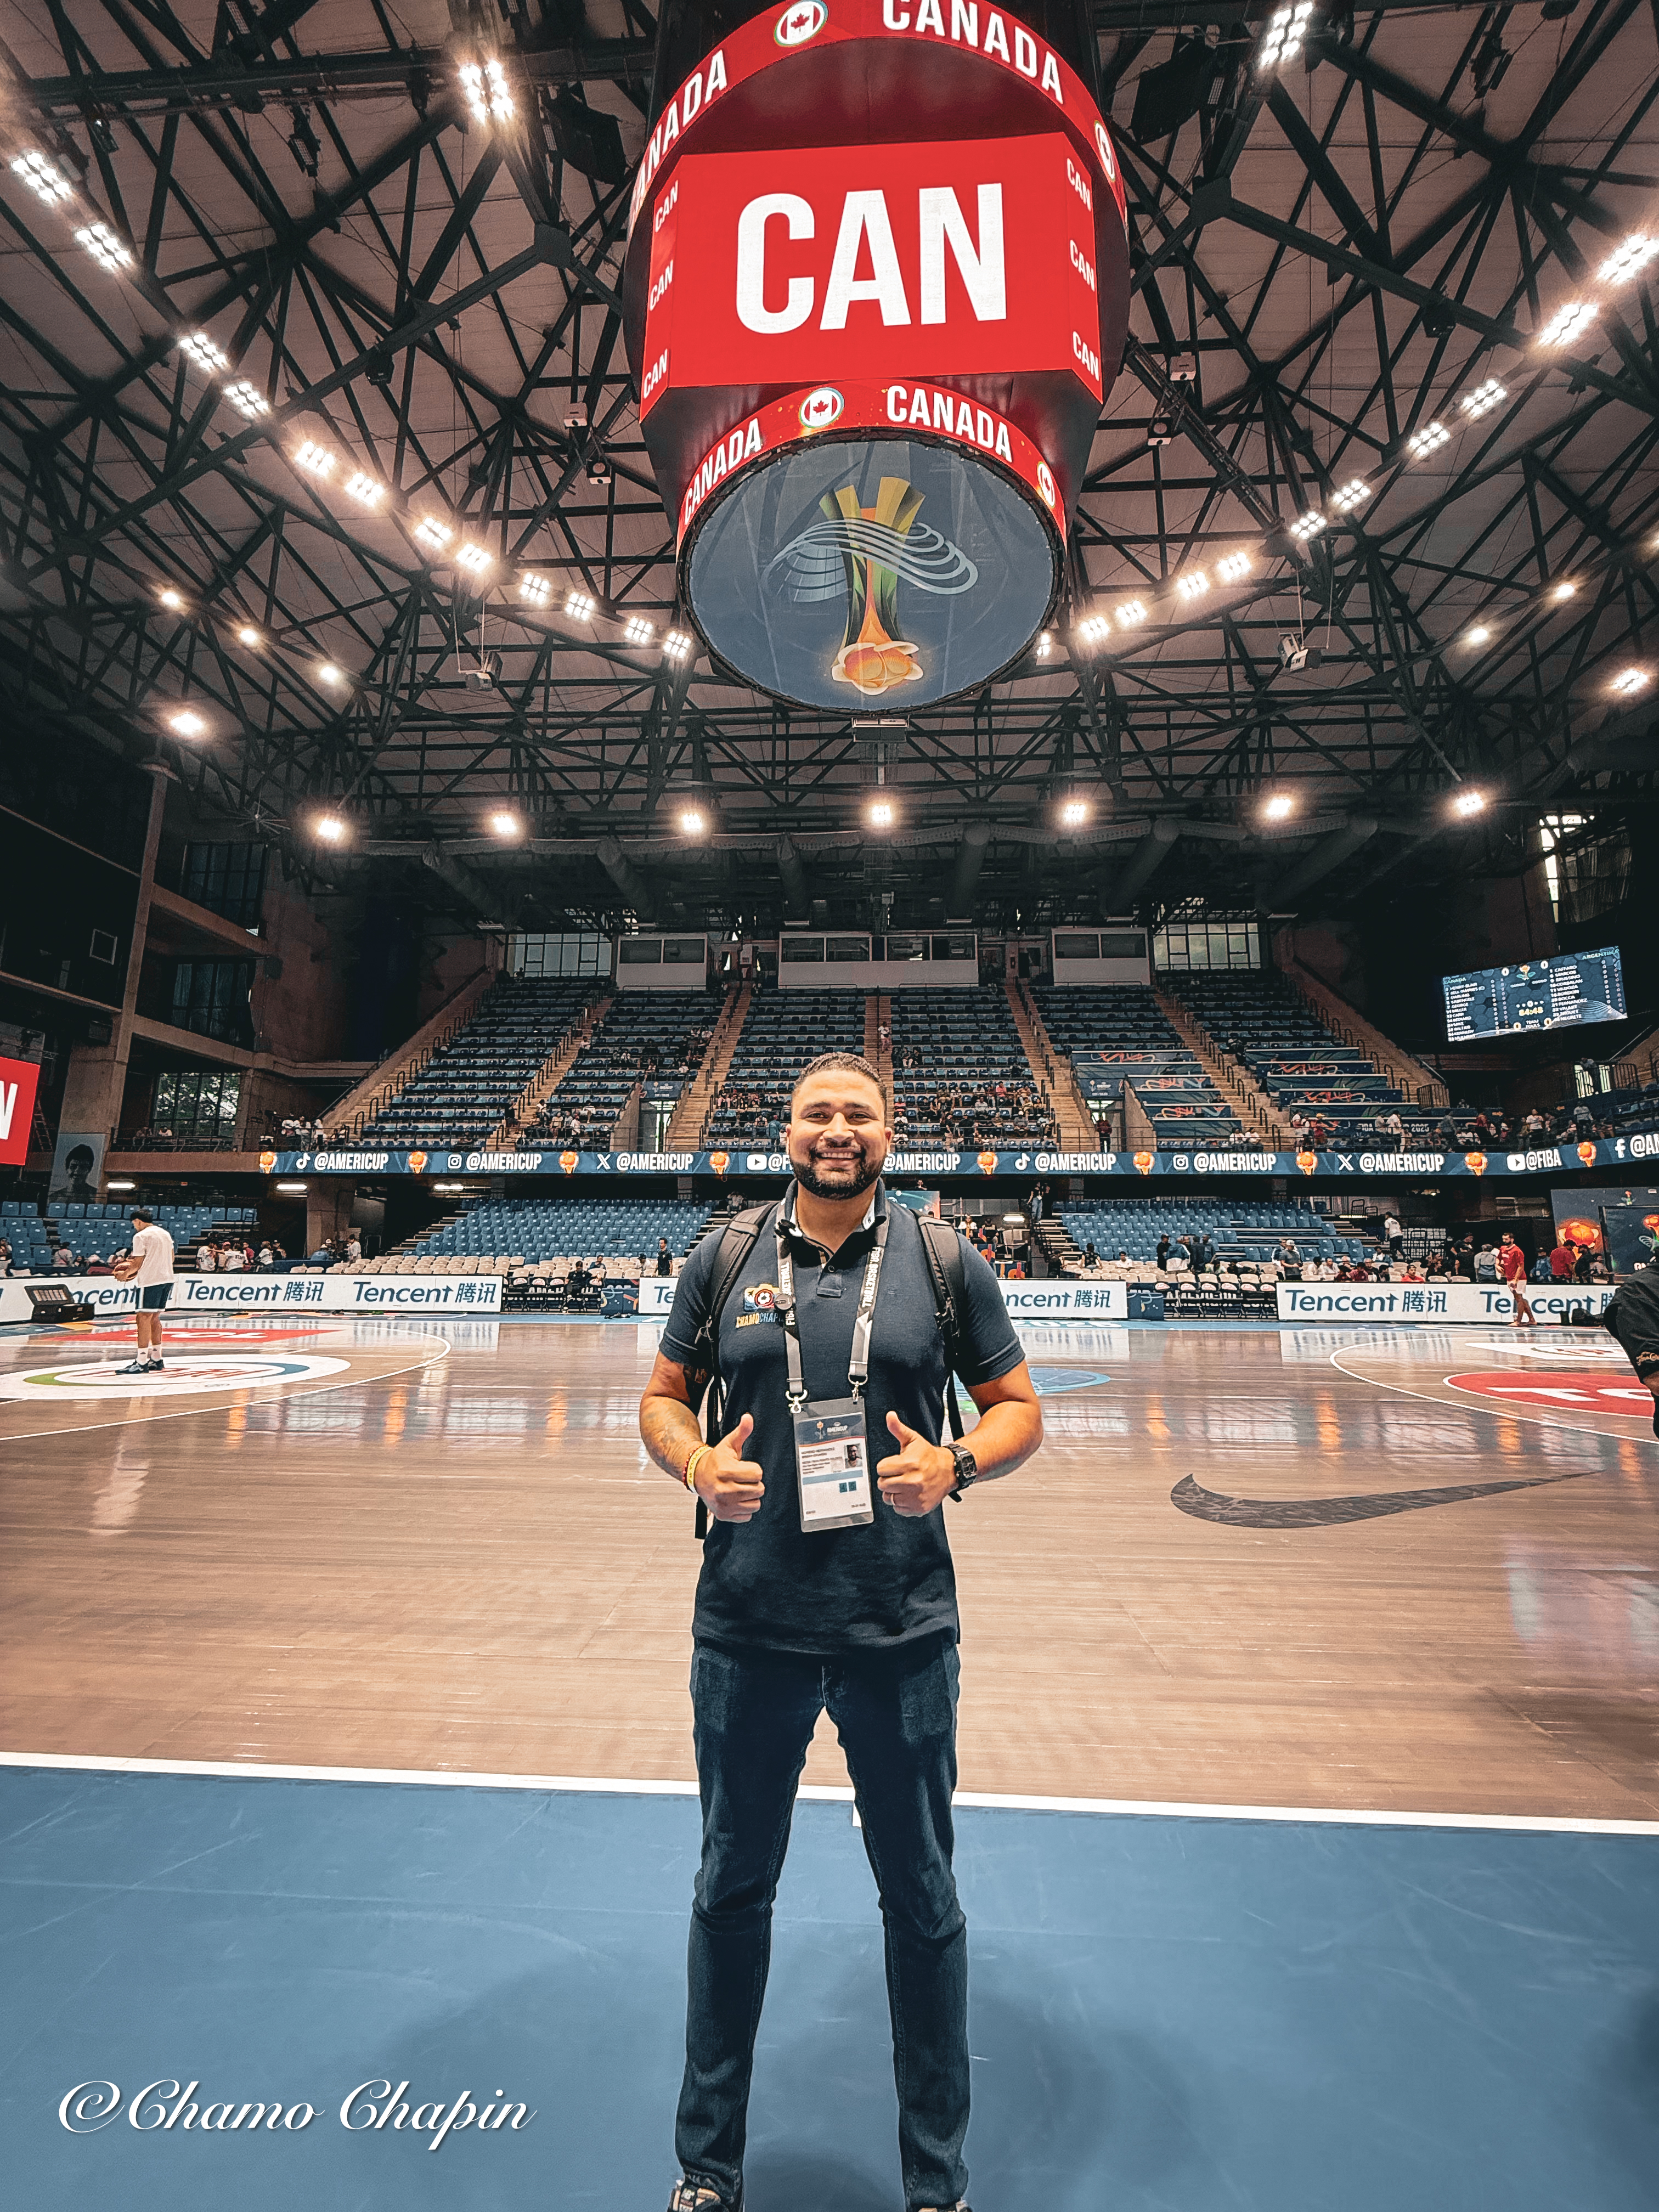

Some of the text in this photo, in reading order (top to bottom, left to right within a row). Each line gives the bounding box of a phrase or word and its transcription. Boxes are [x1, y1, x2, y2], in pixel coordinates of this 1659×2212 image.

[883, 0, 1064, 104] CANADA
[1067, 157, 1092, 212] CAN
[655, 180, 679, 233] CAN
[736, 182, 1006, 335] CAN
[1069, 239, 1095, 292] CAN
[650, 259, 674, 312] CAN
[1072, 331, 1100, 382] CAN
[644, 348, 669, 399] CAN
[887, 385, 1012, 463] CANADA
[684, 417, 761, 520] CANADA
[314, 1153, 388, 1171] @AMERICUP
[466, 1153, 542, 1171] @AMERICUP
[616, 1153, 693, 1171] @AMERICUP
[883, 1153, 960, 1171] @AMERICUP
[1035, 1153, 1116, 1171] @AMERICUP
[1194, 1153, 1276, 1172] @AMERICUP
[1359, 1153, 1444, 1172] @AMERICUP
[1526, 1148, 1562, 1170] @FIBA
[185, 1280, 324, 1302] Tencent 腾讯
[353, 1282, 454, 1303] Tencent
[454, 1282, 495, 1304] 腾讯
[1074, 1290, 1110, 1308] 腾讯
[1285, 1289, 1448, 1313] Tencent 腾讯
[1480, 1291, 1596, 1313] Tecent
